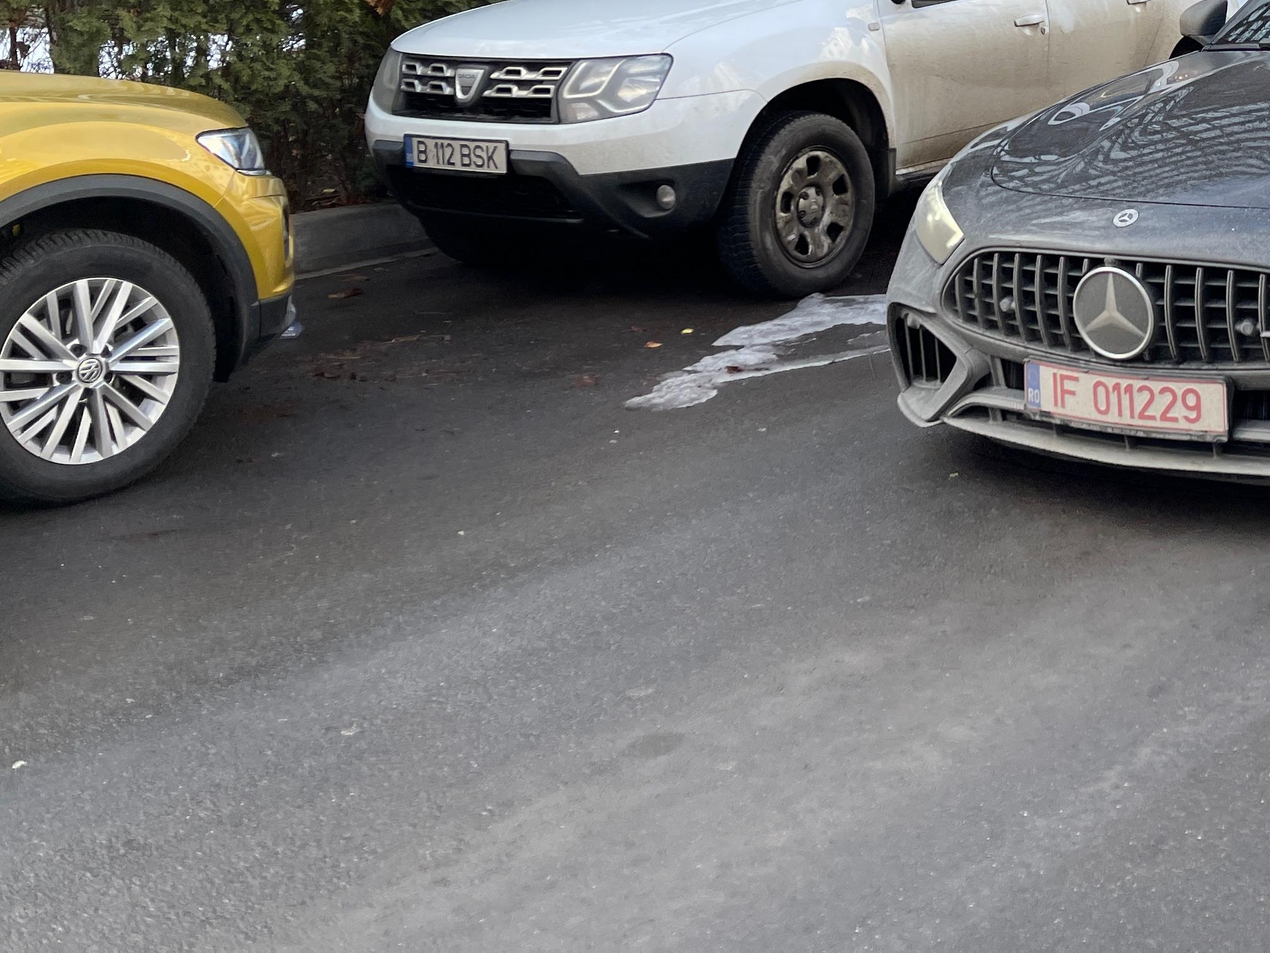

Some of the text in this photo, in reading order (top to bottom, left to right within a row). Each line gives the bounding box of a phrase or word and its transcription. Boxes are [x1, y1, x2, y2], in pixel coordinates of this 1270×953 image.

[416, 140, 499, 170] B 112 BSK
[1028, 387, 1040, 404] RO
[1051, 372, 1202, 424] IF 011229
